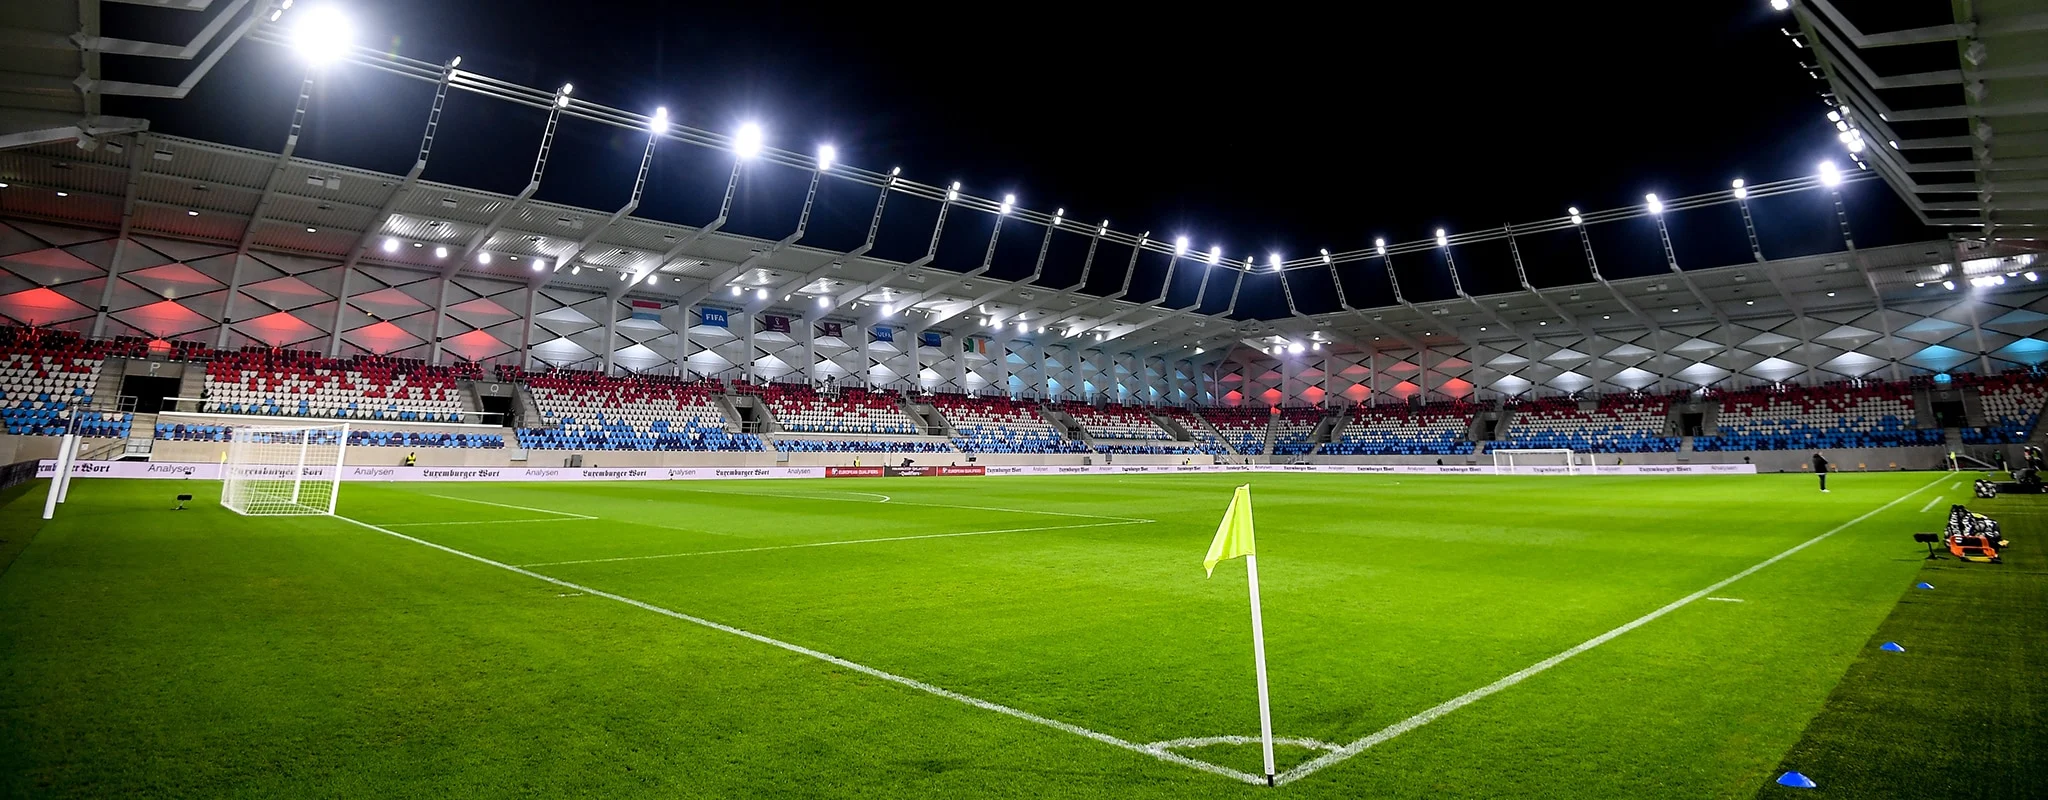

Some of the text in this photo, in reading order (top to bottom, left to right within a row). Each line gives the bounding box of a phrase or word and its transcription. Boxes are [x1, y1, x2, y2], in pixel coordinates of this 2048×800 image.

[705, 313, 724, 322] FIFA
[150, 362, 160, 372] P
[81, 463, 110, 472] Wort
[148, 463, 195, 474] Analysen
[354, 467, 394, 477] Analysen
[423, 469, 500, 479] Luxemburger Wort
[525, 469, 559, 477] Analysen
[583, 470, 628, 479] Luxemburger
[668, 468, 696, 477] Analysen
[716, 469, 754, 478] Luxemburger
